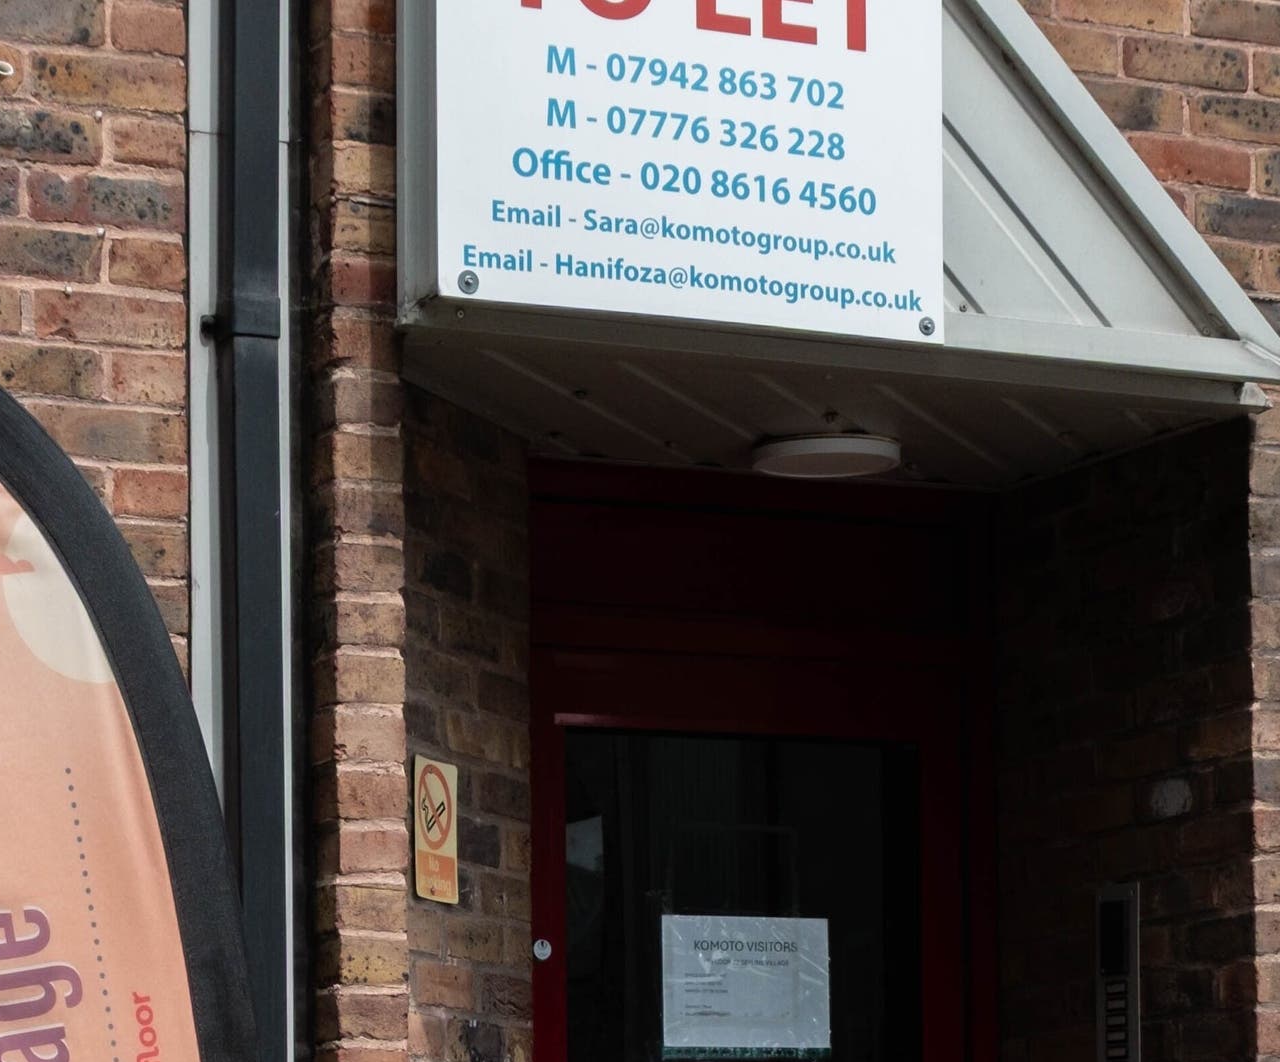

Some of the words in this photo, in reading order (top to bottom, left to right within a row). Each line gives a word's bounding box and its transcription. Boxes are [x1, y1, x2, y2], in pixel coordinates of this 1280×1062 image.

[547, 45, 577, 76] M
[607, 53, 709, 92] 07942
[719, 68, 777, 100] 863
[788, 76, 845, 110] 702
[547, 98, 577, 129] M
[607, 106, 710, 144] 07776
[720, 119, 778, 152] 326
[788, 127, 845, 161] 228
[512, 147, 611, 186] Office
[640, 161, 701, 194] 020
[711, 169, 790, 205] 8616
[799, 182, 877, 216] 4560
[492, 200, 562, 228] Email
[583, 209, 896, 265] Sara@komotogroup.co.uk
[463, 244, 532, 273] Email
[555, 254, 922, 313] Hanifoza@komotogroup.co.uk
[693, 940, 744, 953] KOMOTO
[746, 940, 798, 953] VISITORS
